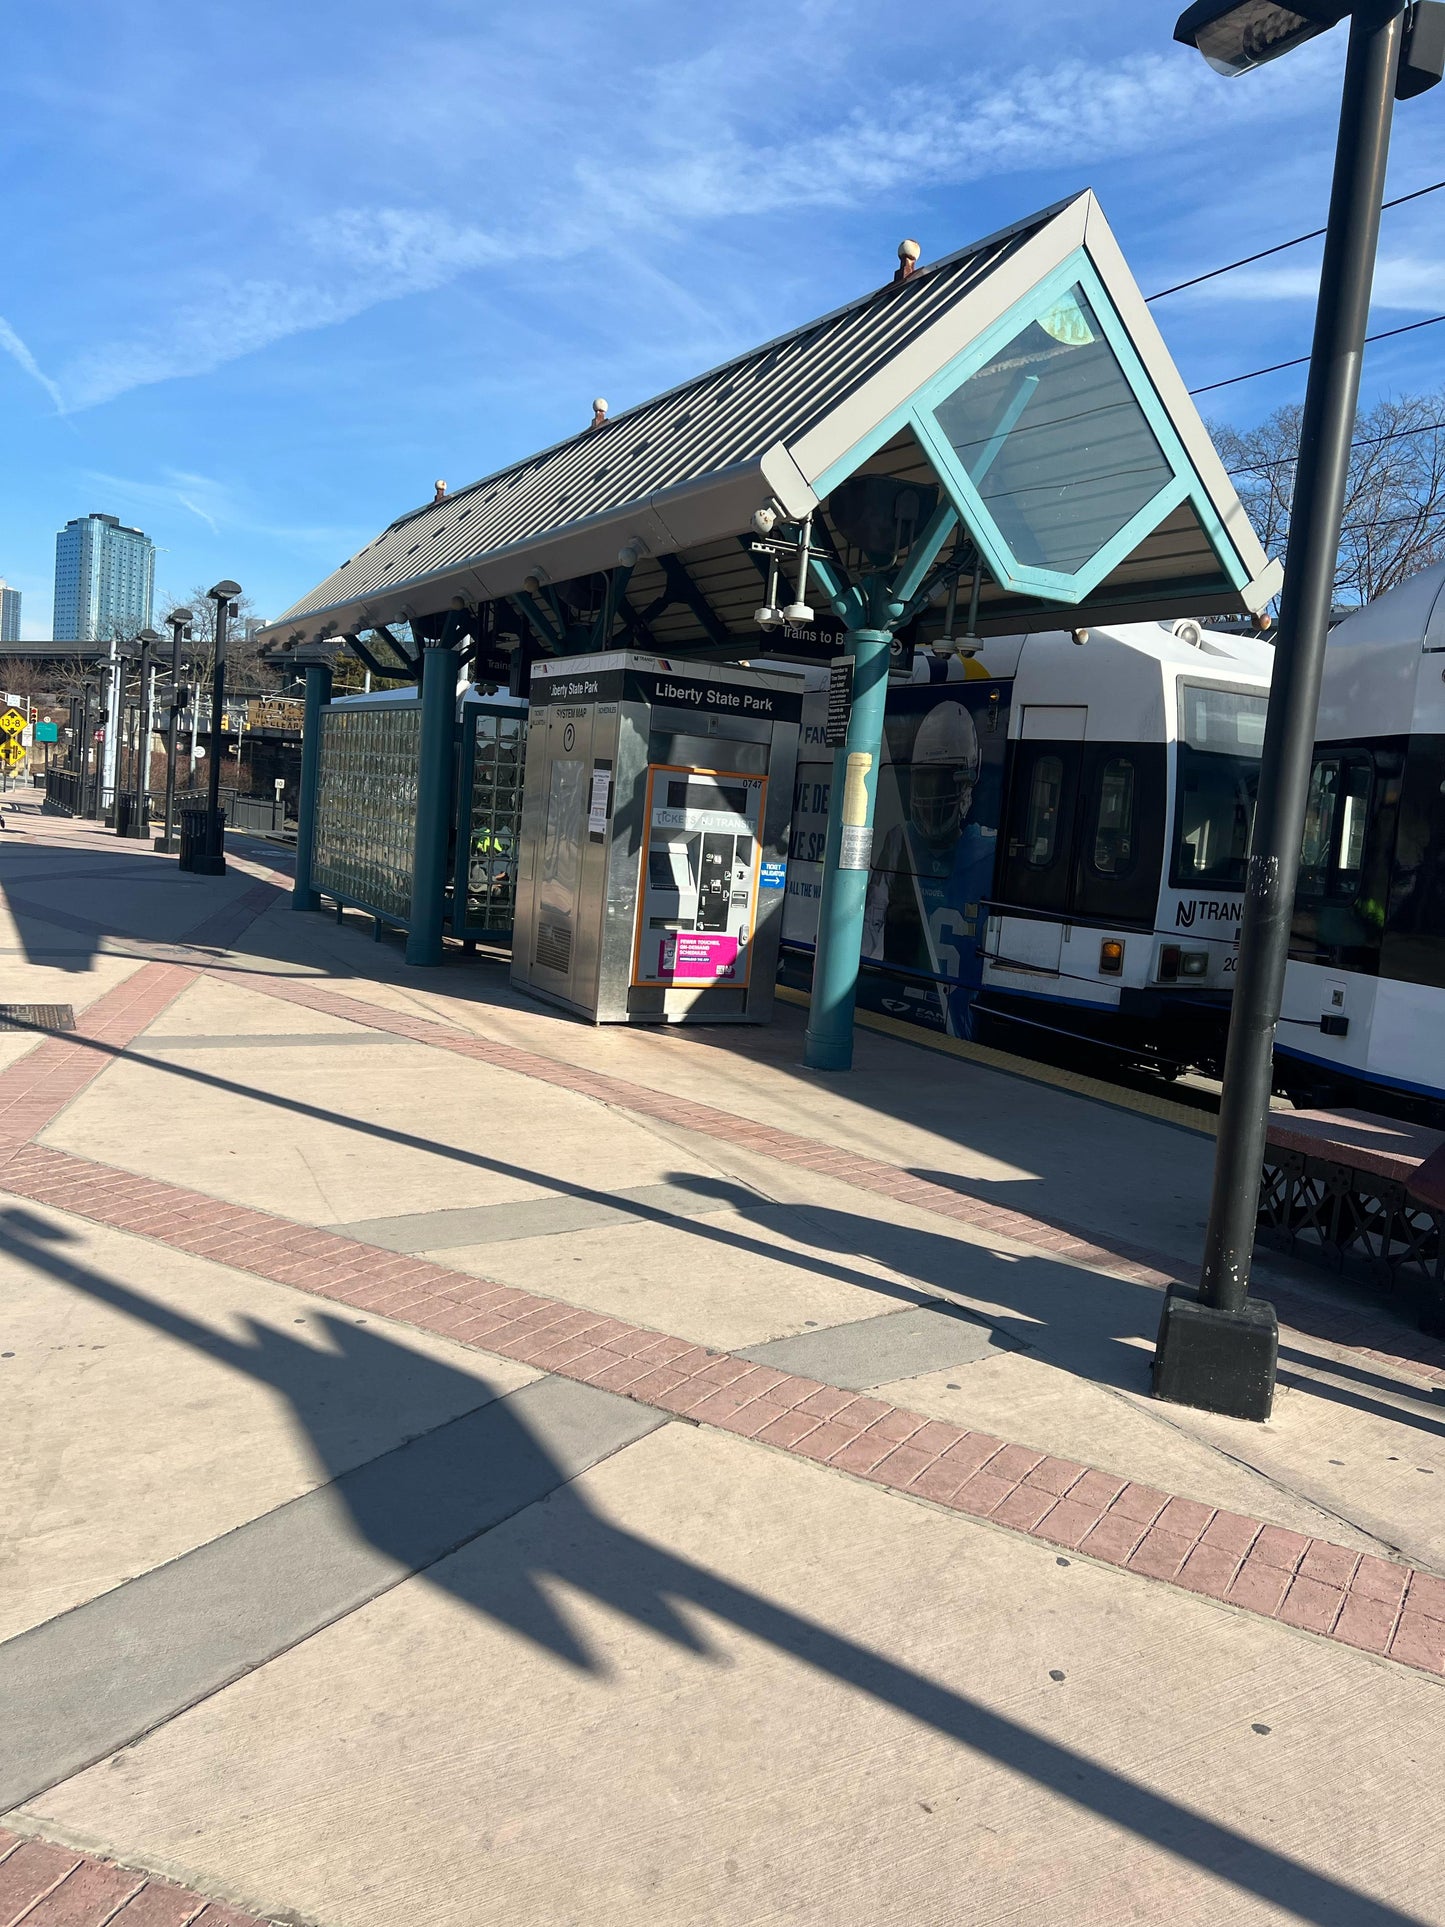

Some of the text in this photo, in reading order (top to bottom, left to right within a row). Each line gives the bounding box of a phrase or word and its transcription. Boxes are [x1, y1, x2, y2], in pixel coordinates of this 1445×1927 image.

[783, 625, 846, 645] Trains to B
[568, 682, 583, 695] State
[584, 680, 599, 693] Park
[656, 682, 773, 711] Liberty State Park
[557, 707, 587, 718] SYSTEM MAP
[742, 779, 762, 789] 0747
[656, 811, 756, 829] TICKETS NJ TRANSIT
[761, 869, 785, 877] VALIDATOR
[789, 881, 799, 895] ALL
[801, 882, 812, 897] THE
[1175, 900, 1245, 927] NJ TRAN
